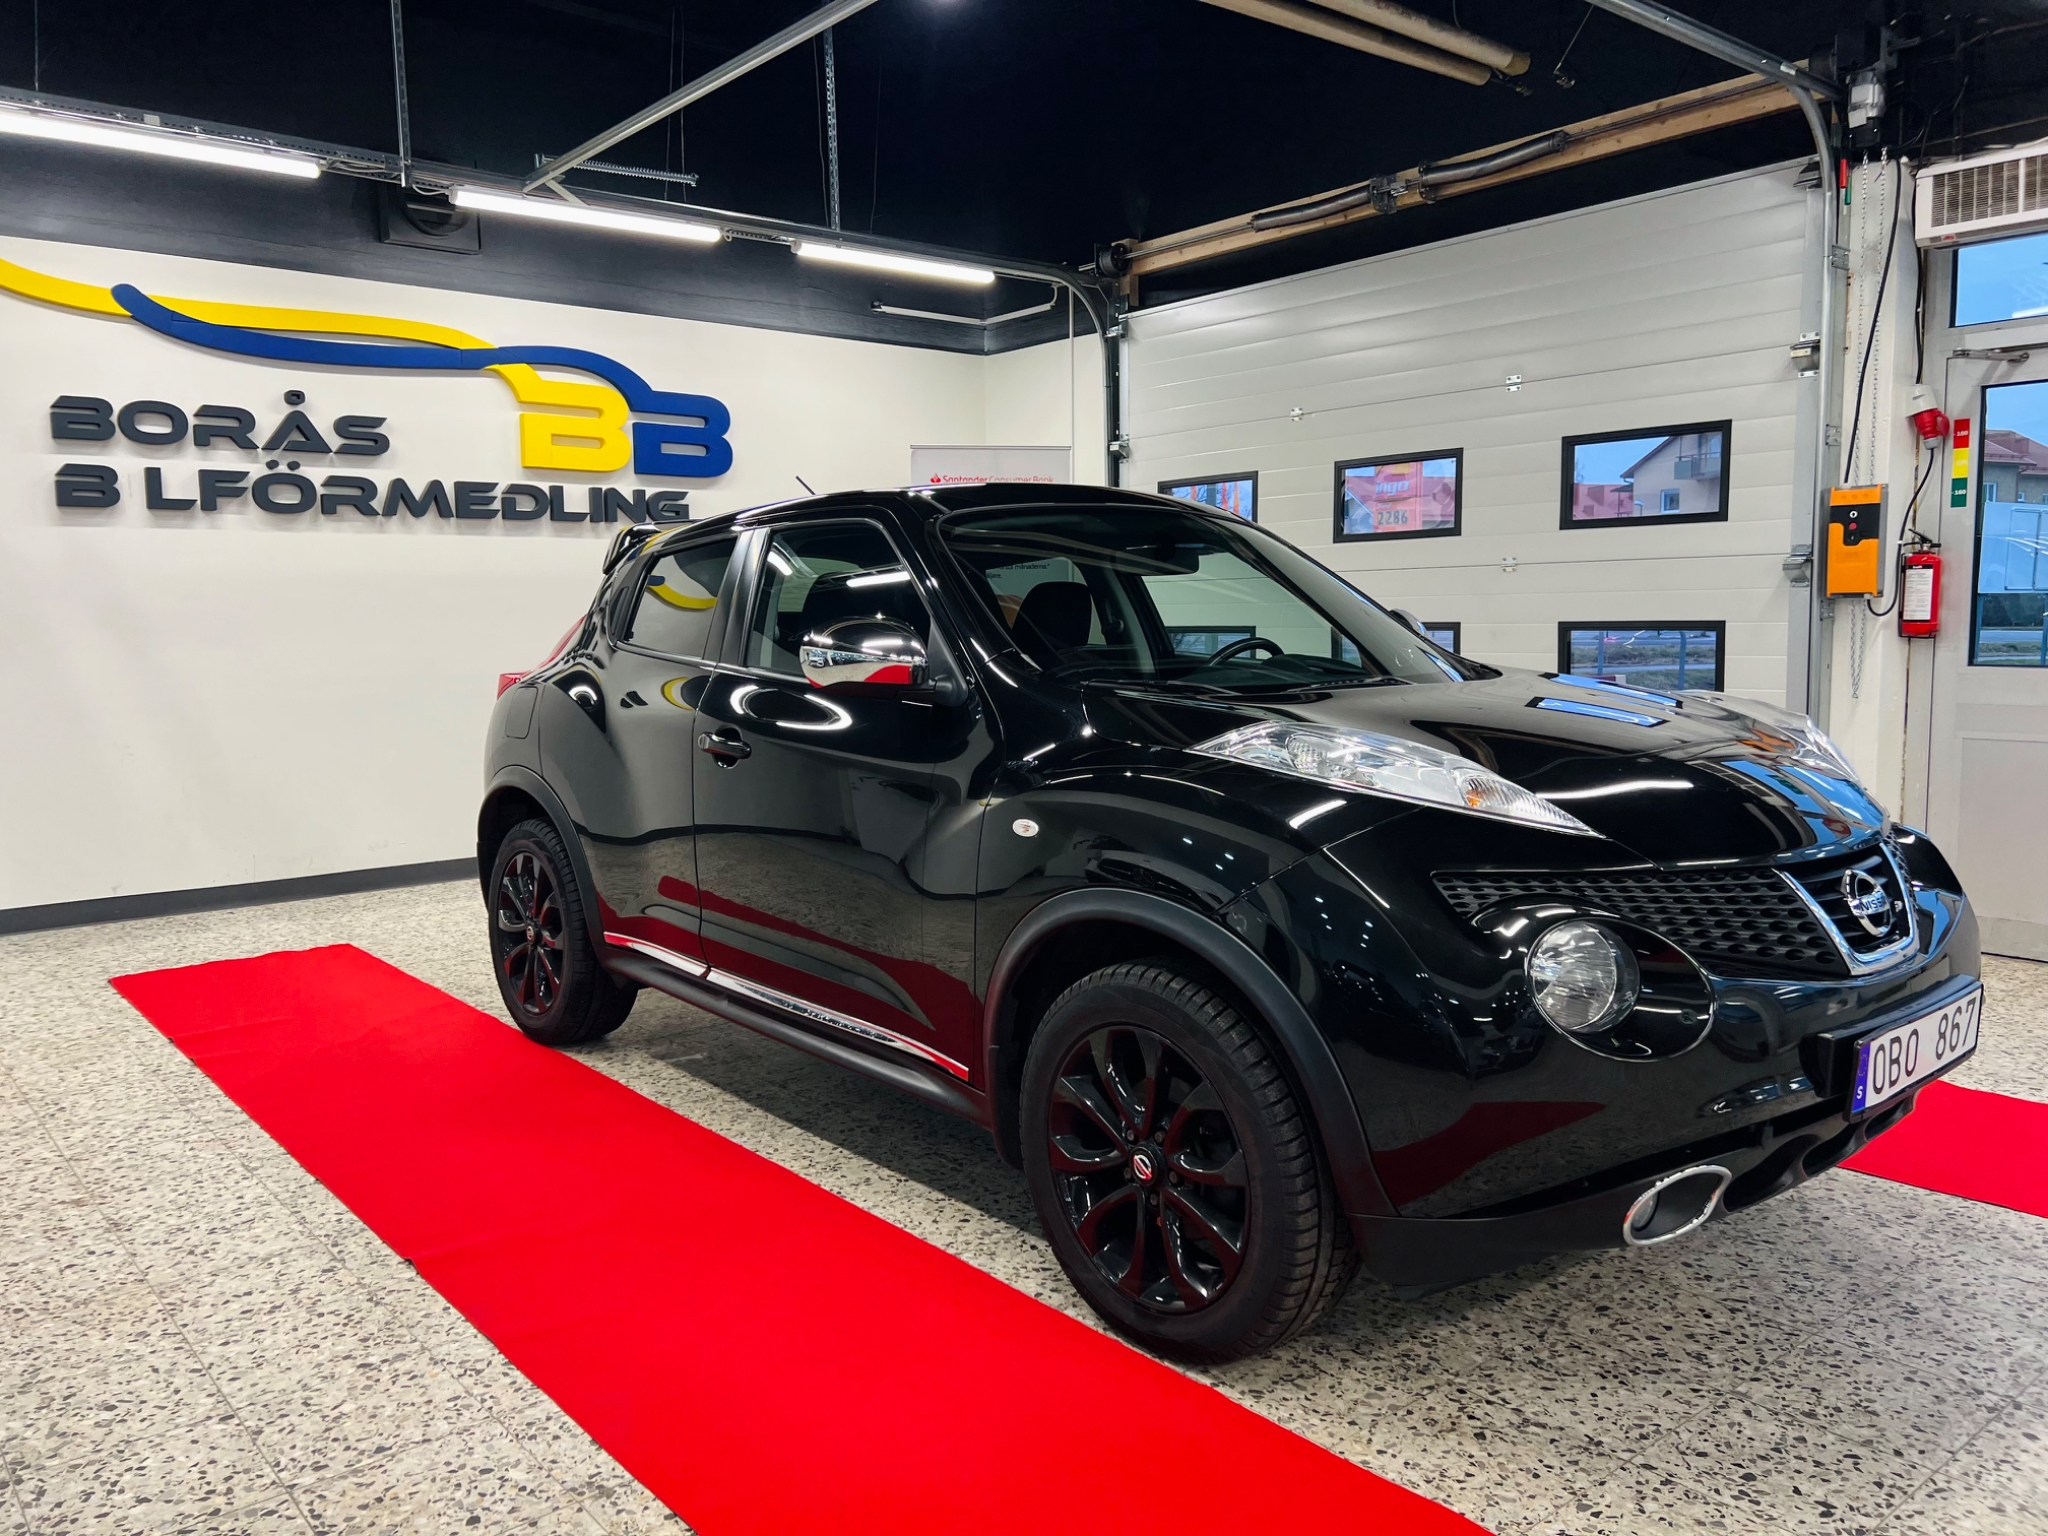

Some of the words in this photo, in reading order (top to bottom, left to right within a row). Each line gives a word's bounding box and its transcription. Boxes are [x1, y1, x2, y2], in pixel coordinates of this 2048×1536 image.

[50, 390, 390, 456] BORÅS
[943, 475, 988, 483] Santander
[1376, 480, 1410, 496] ingo
[1377, 510, 1408, 525] 2286
[1860, 895, 1888, 912] NISS
[1935, 996, 1977, 1061] 867
[1856, 1085, 1863, 1100] S
